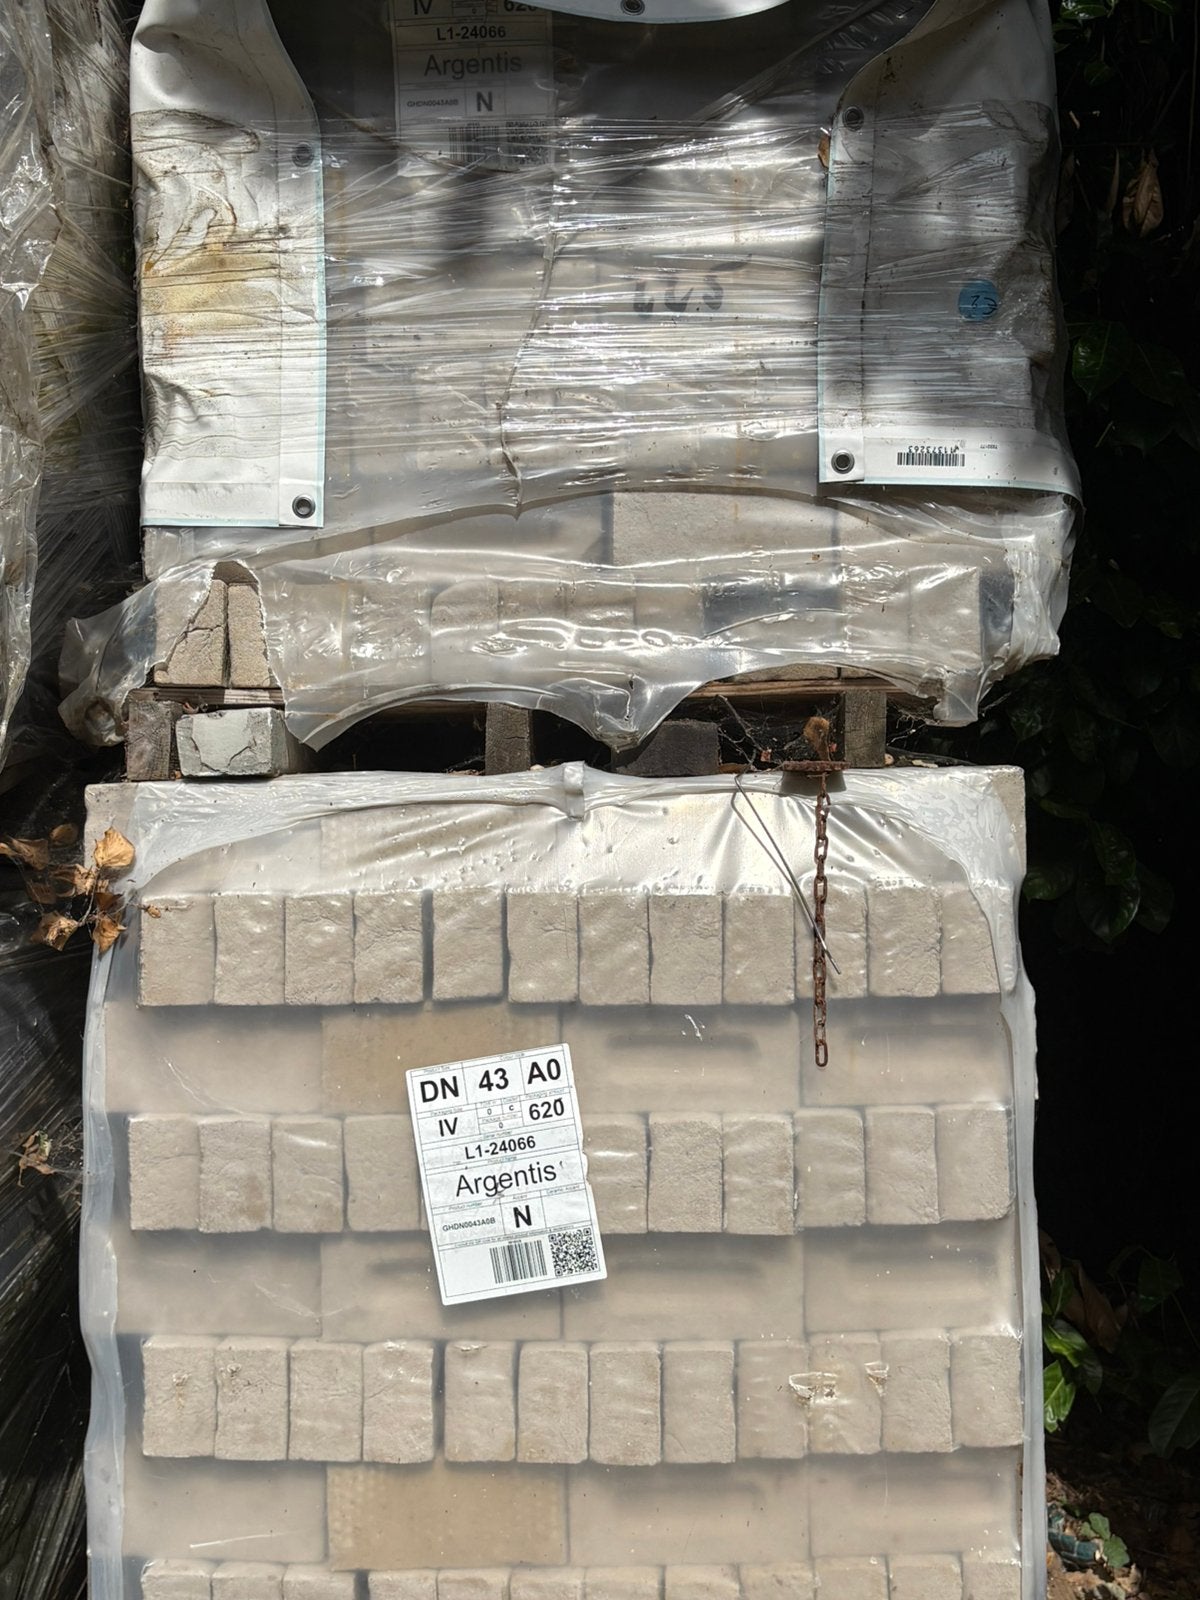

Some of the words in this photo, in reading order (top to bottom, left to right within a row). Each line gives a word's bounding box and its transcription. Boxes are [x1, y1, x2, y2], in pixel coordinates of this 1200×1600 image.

[436, 25, 507, 41] L1-24066
[424, 52, 523, 80] Argentis
[476, 91, 494, 112] N
[478, 1067, 509, 1092] 43
[527, 1058, 562, 1085] A0
[420, 1075, 460, 1103] DN
[529, 1098, 565, 1121] 620
[438, 1117, 458, 1137] IV
[465, 1135, 536, 1160] L1-24066
[456, 1161, 557, 1198] Argentis
[442, 1217, 496, 1232] GHDN0043A0B
[513, 1205, 532, 1229] N
